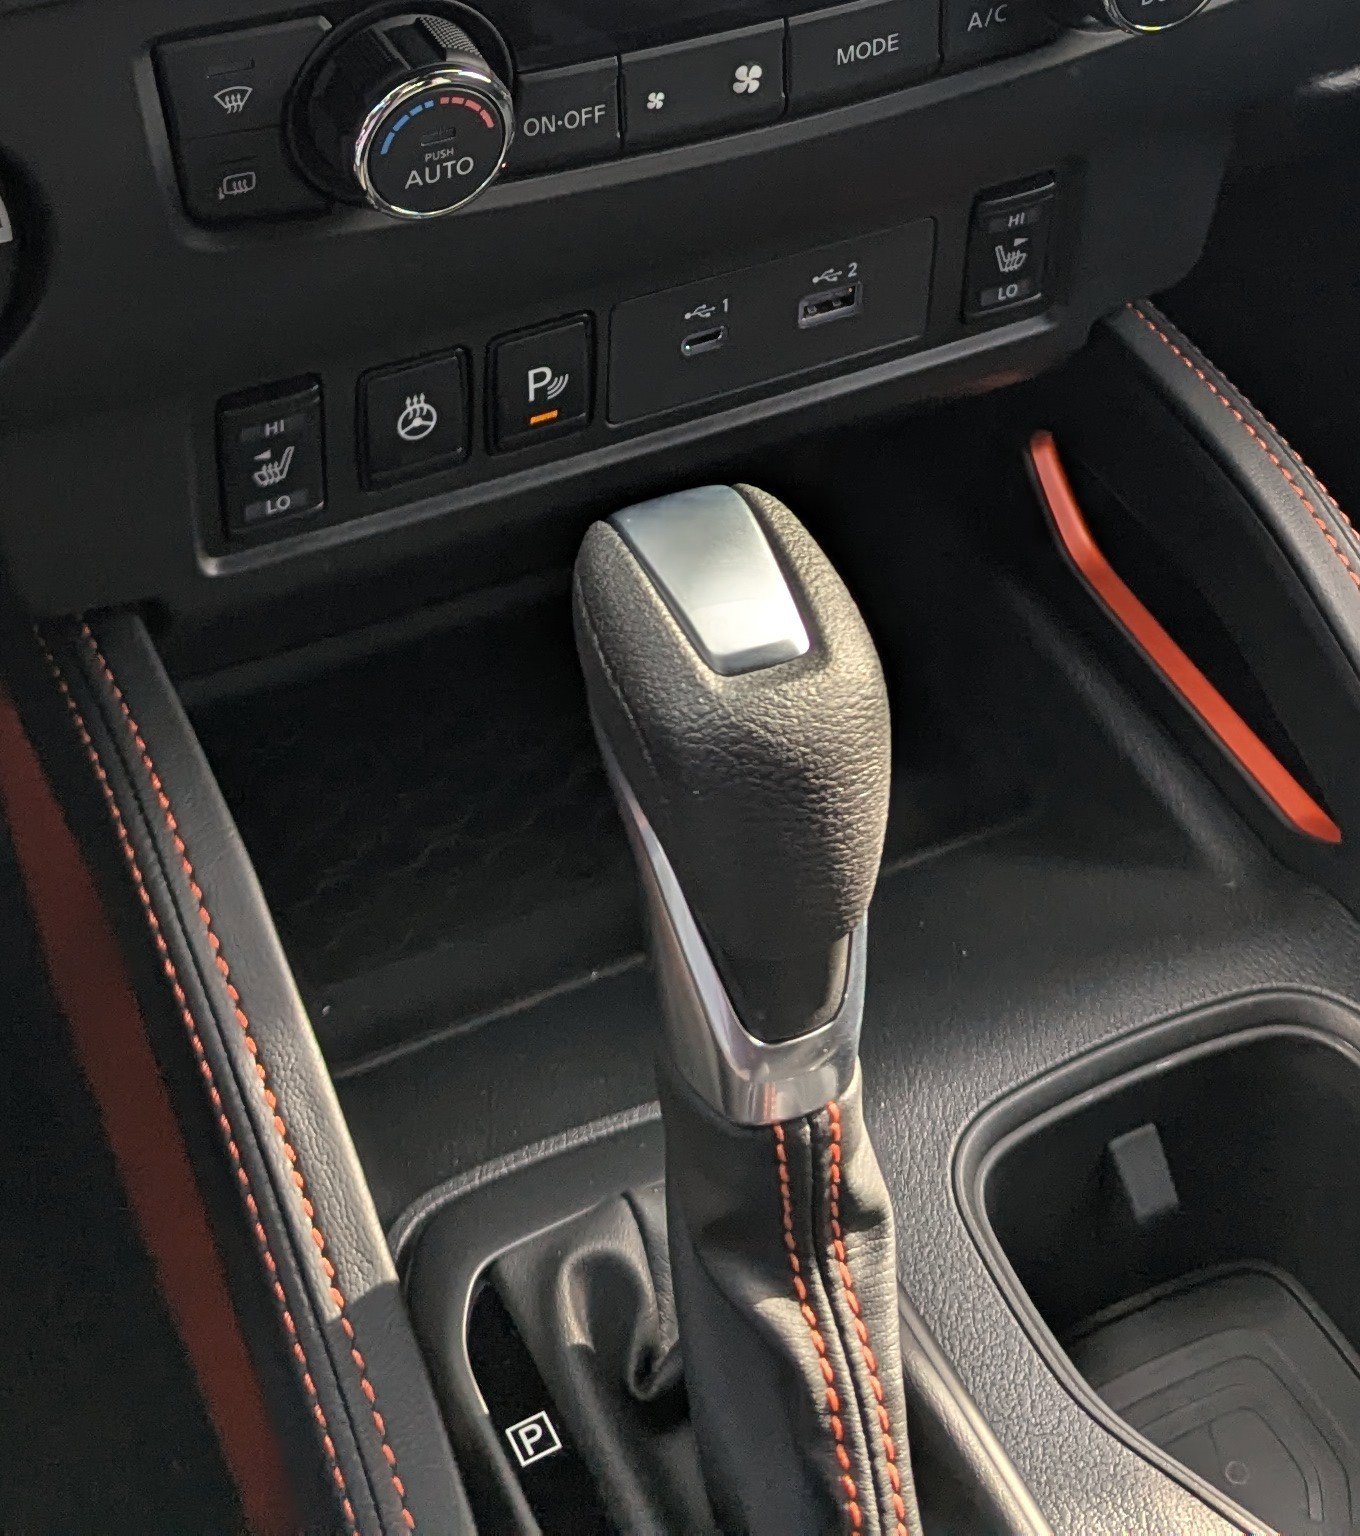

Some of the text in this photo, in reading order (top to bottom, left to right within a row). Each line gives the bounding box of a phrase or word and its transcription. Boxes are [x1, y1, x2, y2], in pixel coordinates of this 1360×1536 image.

[967, 4, 1007, 32] A/C
[837, 32, 899, 65] MODE
[425, 146, 454, 162] PUSH
[405, 156, 474, 189] AUTO
[1007, 212, 1025, 228] HI
[997, 284, 1019, 301] LO
[527, 366, 552, 402] P
[265, 420, 285, 438] HI
[266, 494, 291, 515] LO
[518, 1423, 543, 1456] P
